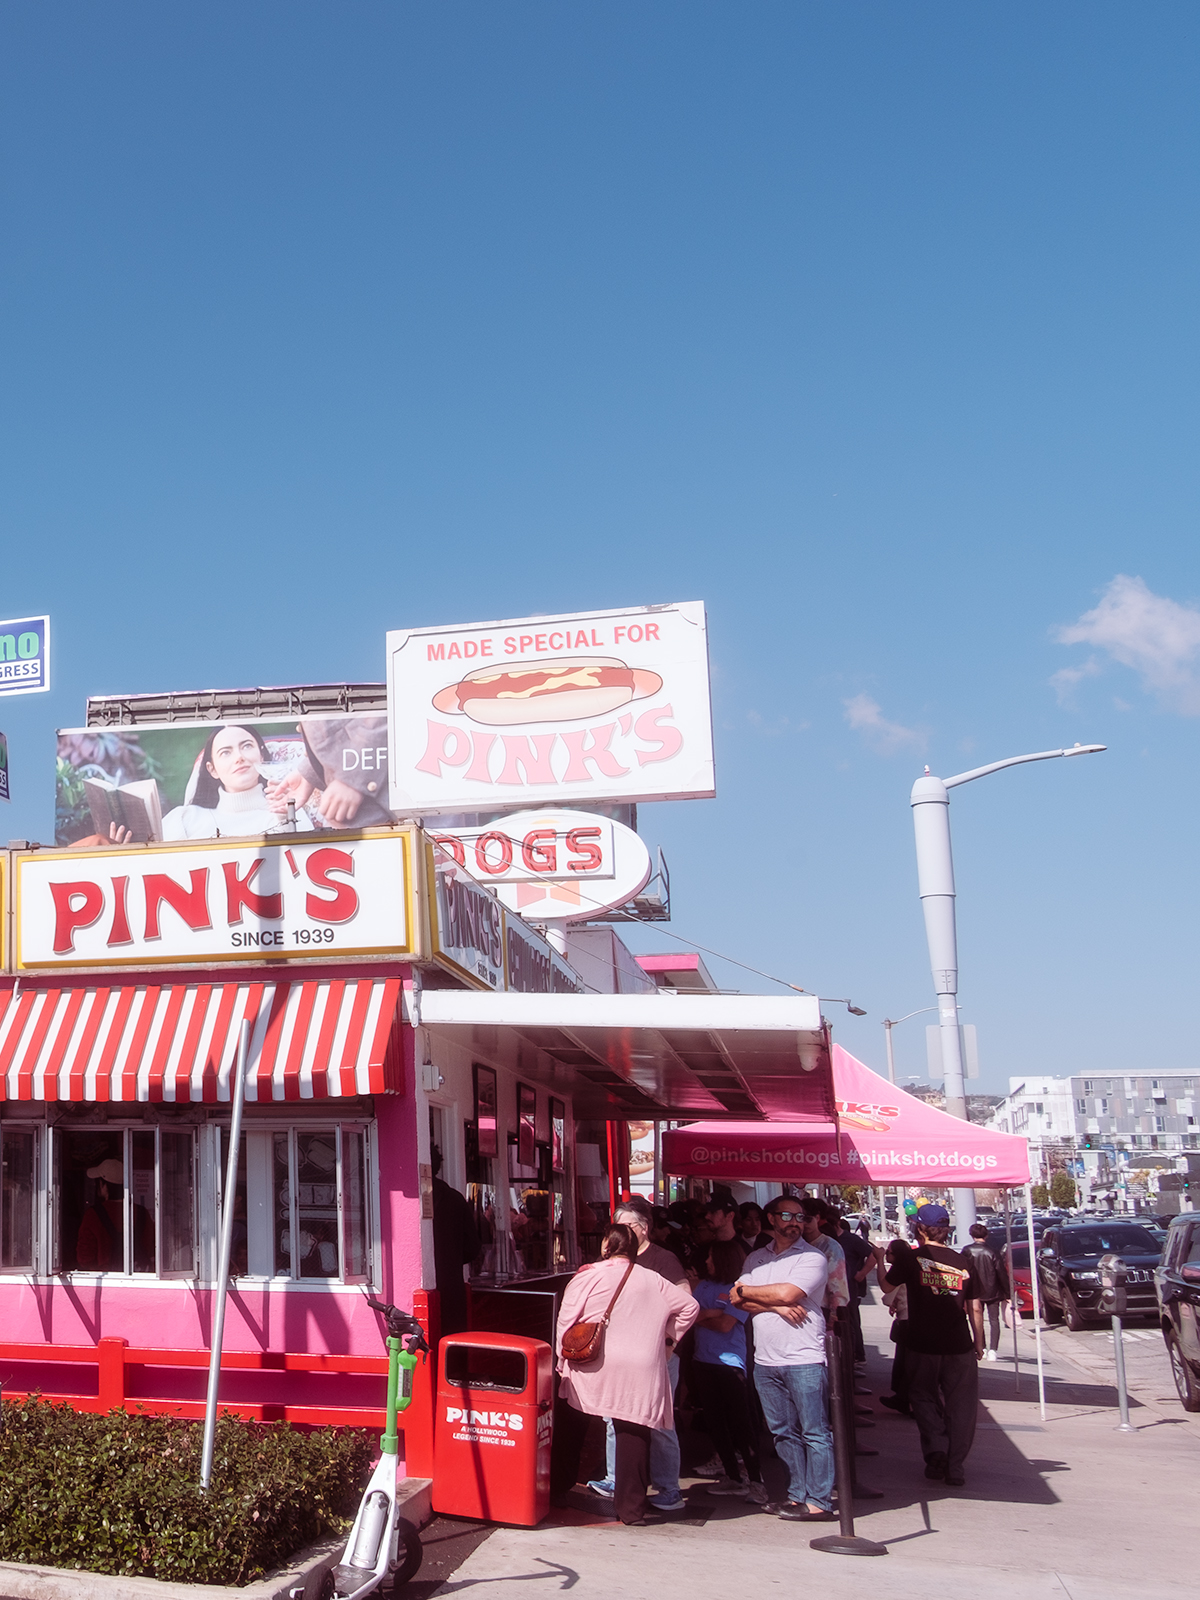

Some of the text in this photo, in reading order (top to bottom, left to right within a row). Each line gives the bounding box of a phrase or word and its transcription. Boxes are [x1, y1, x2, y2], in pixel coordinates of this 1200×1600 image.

[427, 623, 661, 661] MADE SPECIAL FOR
[415, 703, 684, 786] PINK'S
[48, 847, 359, 955] PINK'S
[231, 928, 335, 947] SINCE 1939
[690, 1146, 998, 1171] @pinkshotdogs #pinkshotdogs
[922, 1272, 960, 1282] IN-N-OUT
[922, 1278, 959, 1288] BURGER
[446, 1406, 524, 1431] PINK'S
[452, 1432, 516, 1447] LEGEND SINCE 1939
[467, 1427, 508, 1437] HOLLYWOOD
